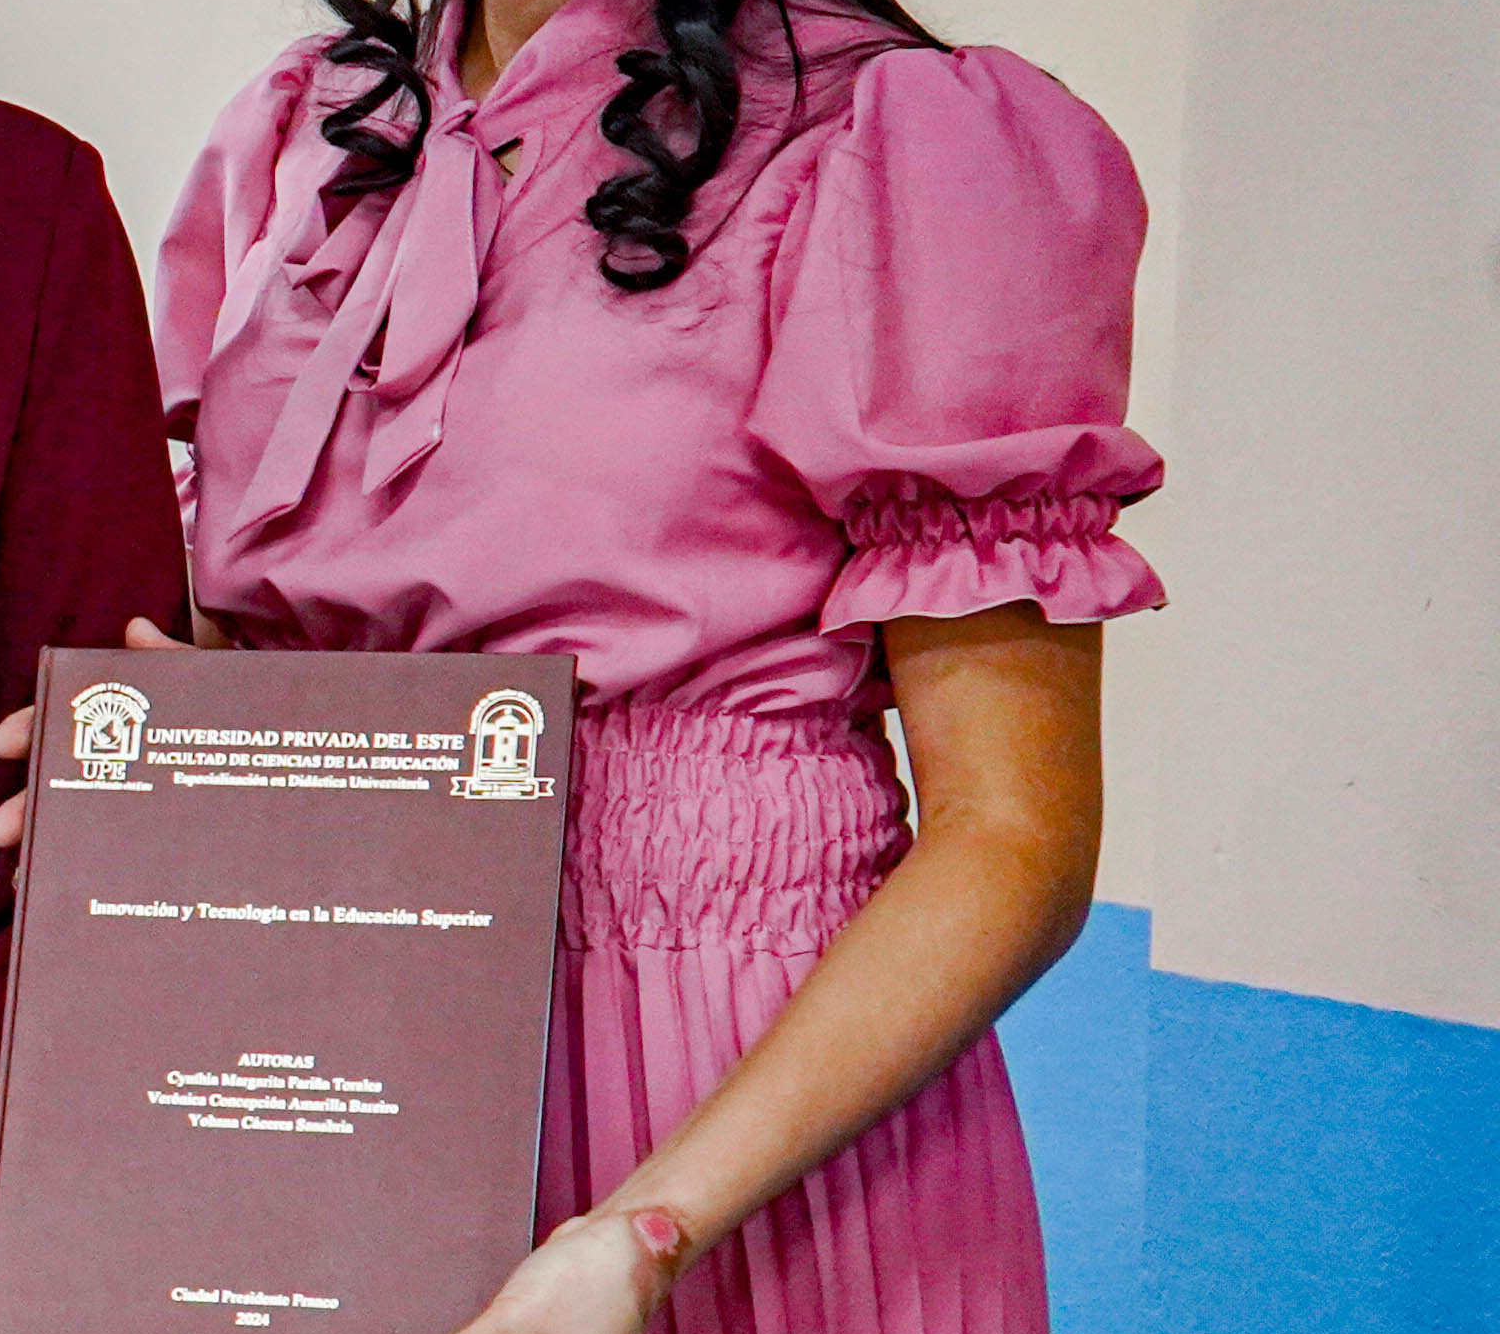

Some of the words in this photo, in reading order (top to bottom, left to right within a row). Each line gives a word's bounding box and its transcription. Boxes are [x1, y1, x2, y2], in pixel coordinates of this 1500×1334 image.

[146, 728, 280, 747] UNIVERSIDAD
[281, 730, 370, 749] PRIVADA
[373, 732, 413, 750] DEL
[415, 733, 465, 751] ESTE
[80, 760, 128, 781] UPE
[146, 750, 228, 766] FACULTAD
[228, 752, 251, 767] DE
[250, 753, 322, 769] CIENCIAS
[323, 754, 346, 769] DE
[346, 755, 369, 770] LA
[370, 755, 460, 771] EDUCACIÓN
[89, 898, 179, 918] Innovación
[180, 905, 195, 922] y
[313, 905, 330, 923] la
[332, 906, 419, 925] Educación
[420, 908, 493, 930] Superior
[237, 1052, 315, 1070] AUTORAS
[234, 1311, 271, 1327] 2024
